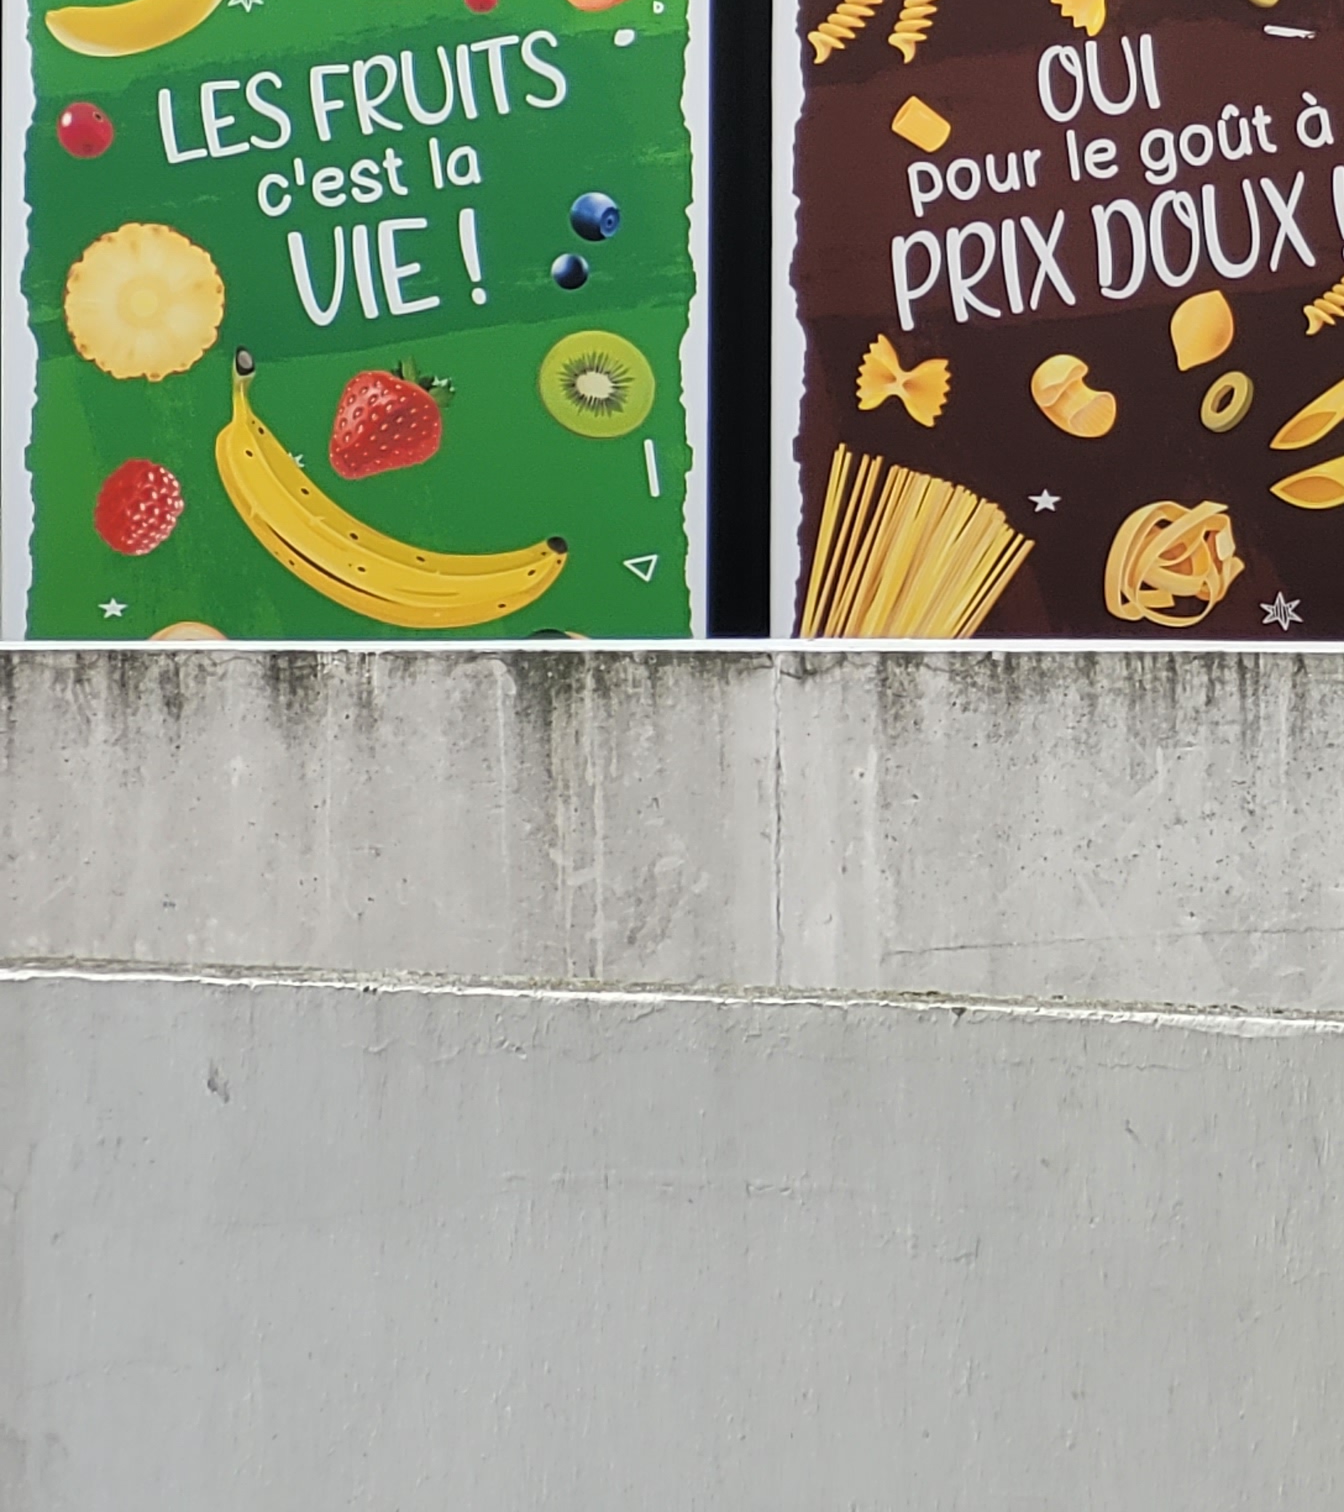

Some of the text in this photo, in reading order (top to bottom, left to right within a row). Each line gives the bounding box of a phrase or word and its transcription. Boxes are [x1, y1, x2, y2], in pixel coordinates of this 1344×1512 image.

[158, 29, 567, 164] LES FRUITS
[1038, 33, 1162, 123] OUI
[257, 137, 482, 217] c'est la
[907, 91, 1335, 218] pour le goût à
[287, 217, 441, 327] VIE
[891, 209, 1077, 332] PRIX
[1091, 170, 1316, 300] DOUX
